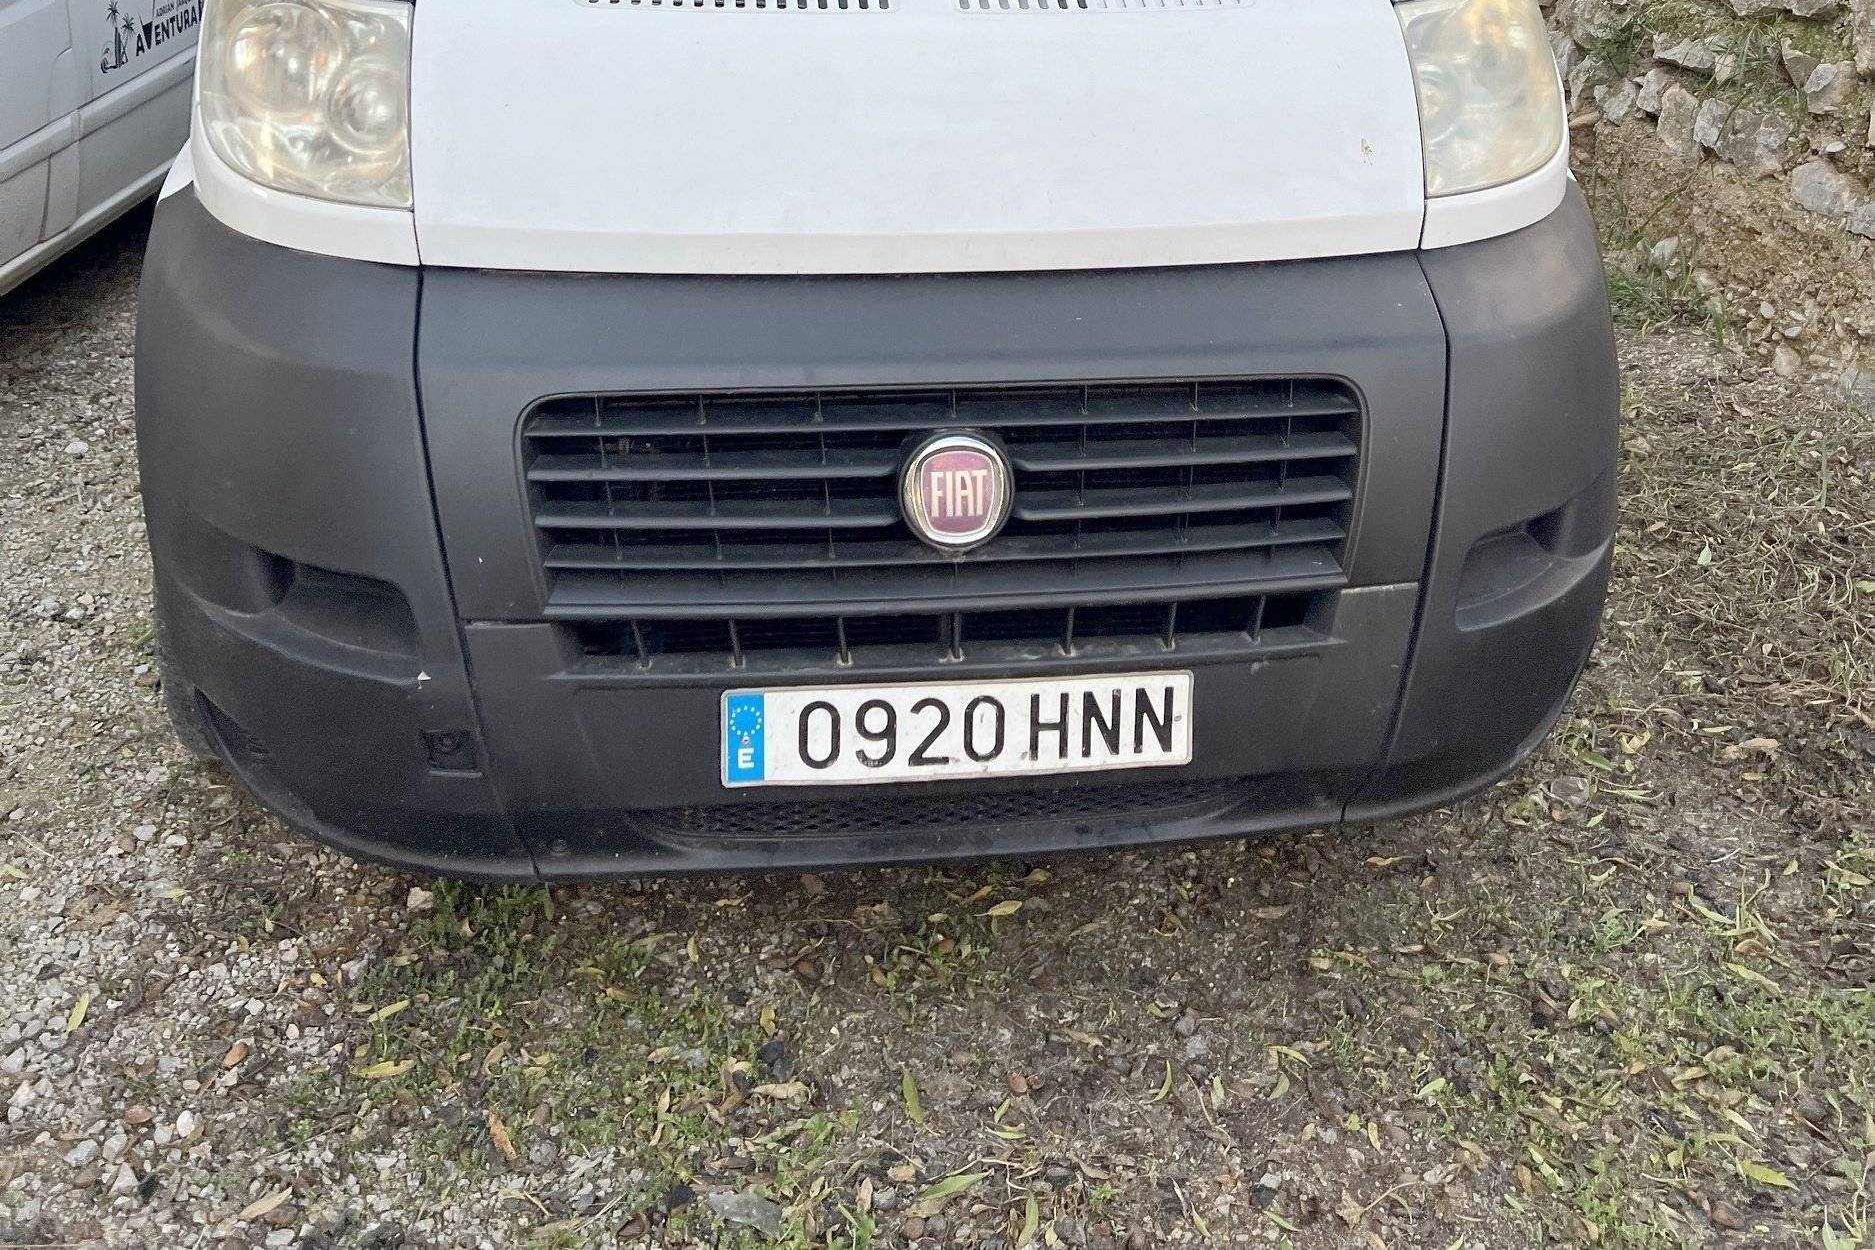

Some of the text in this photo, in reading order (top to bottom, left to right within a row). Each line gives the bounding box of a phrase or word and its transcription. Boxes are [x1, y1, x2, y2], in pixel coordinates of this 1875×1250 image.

[930, 469, 988, 518] FIAT
[798, 686, 1175, 770] 0920 HNN
[737, 747, 755, 769] E
